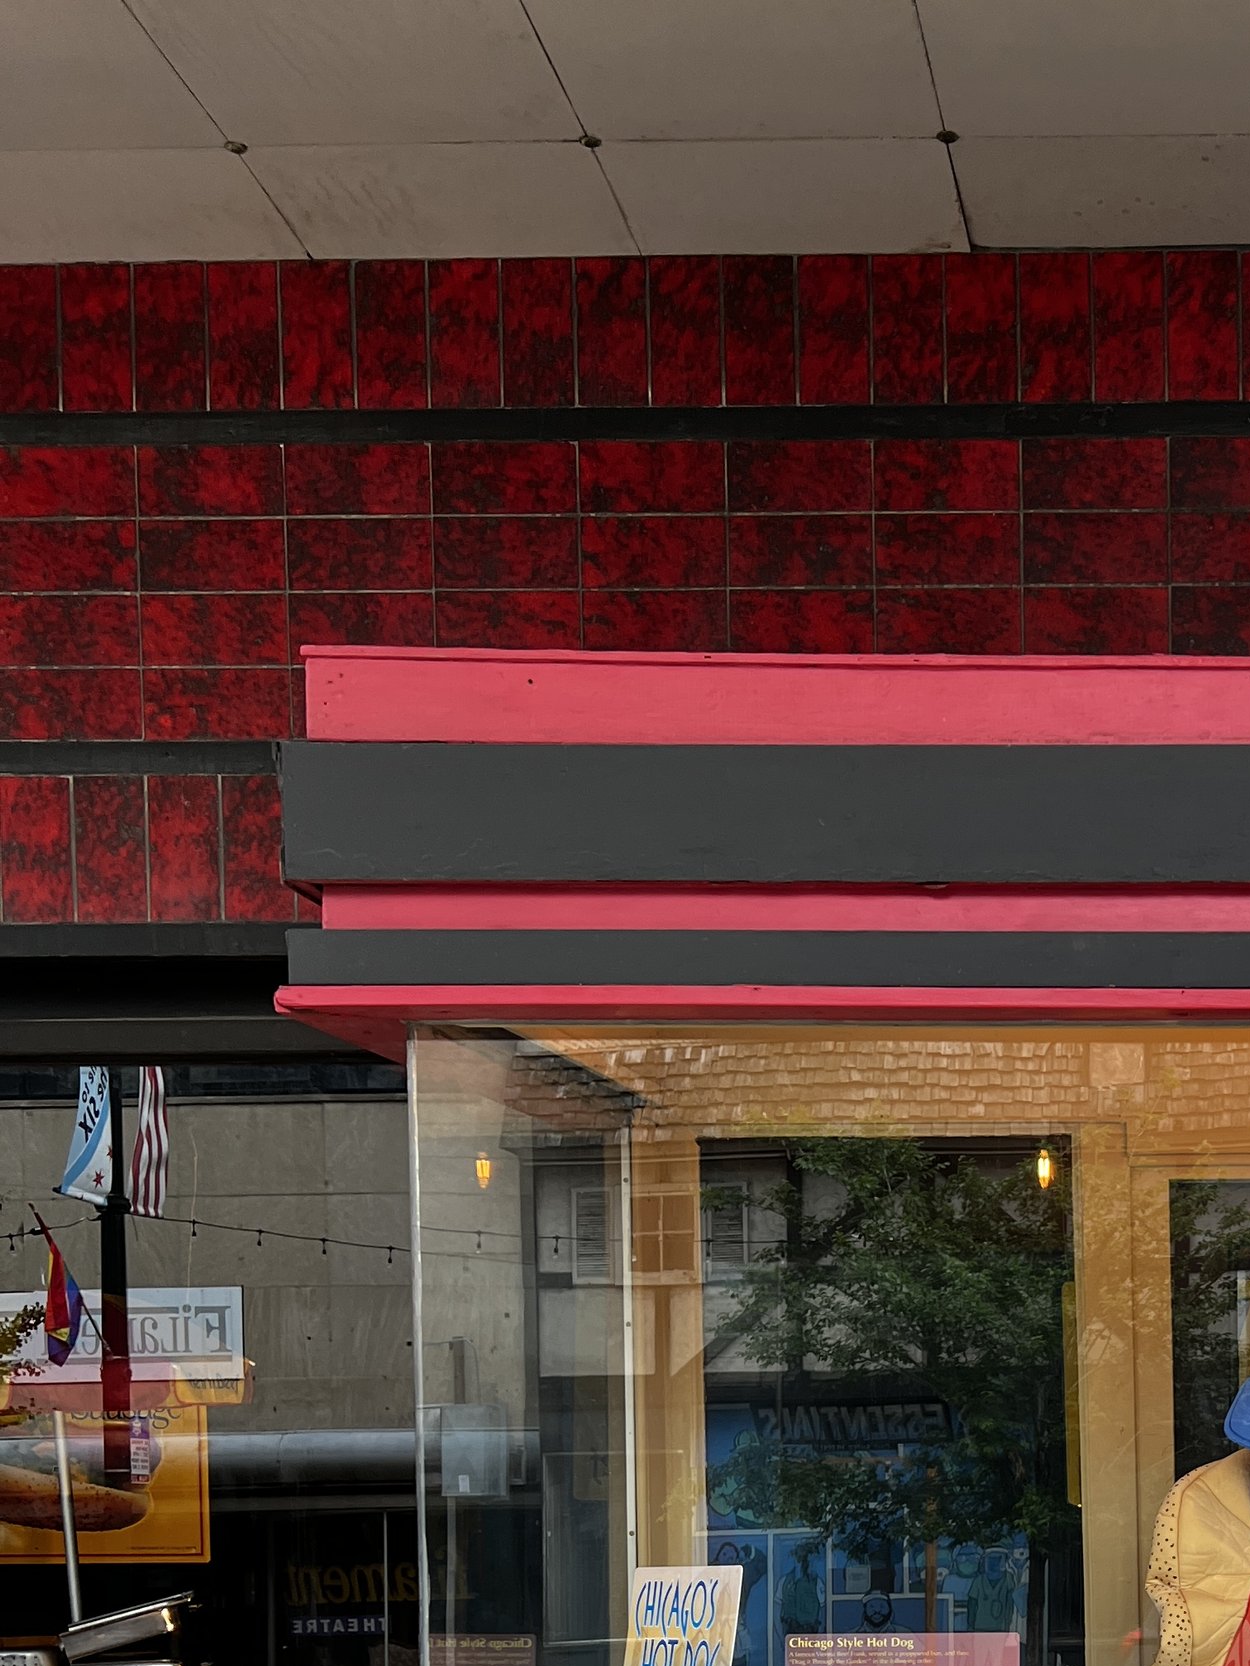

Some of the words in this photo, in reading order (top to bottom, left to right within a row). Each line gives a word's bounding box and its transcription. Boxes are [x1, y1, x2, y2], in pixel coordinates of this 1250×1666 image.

[635, 1578, 719, 1638] CHICAGO'S
[789, 1637, 834, 1651] Chicago
[836, 1637, 864, 1650] Style
[866, 1637, 888, 1648] Hot
[890, 1637, 915, 1650] Dog
